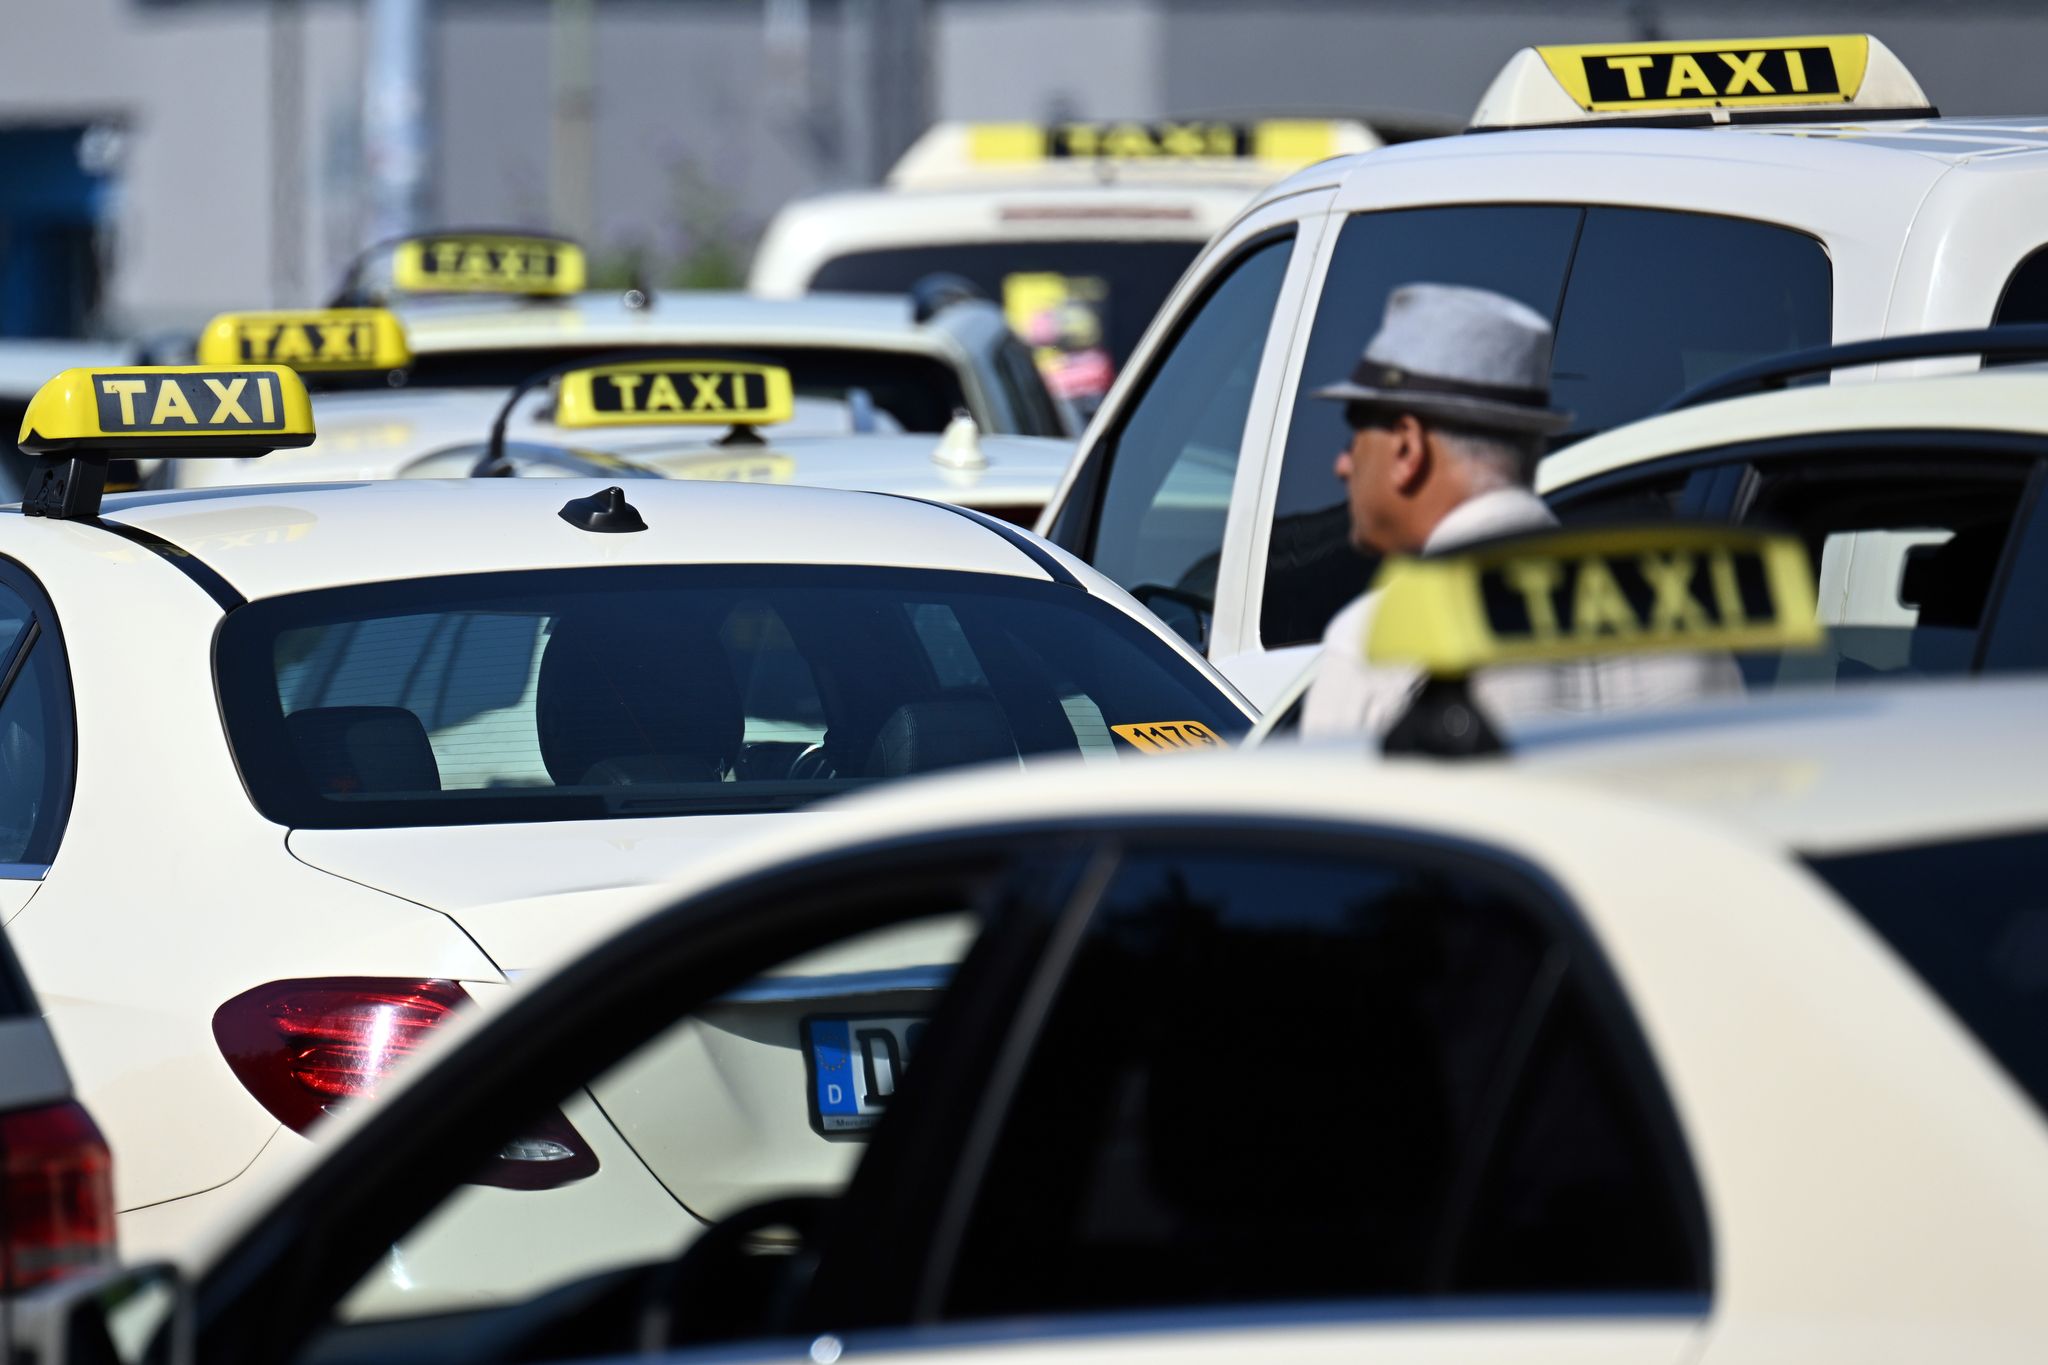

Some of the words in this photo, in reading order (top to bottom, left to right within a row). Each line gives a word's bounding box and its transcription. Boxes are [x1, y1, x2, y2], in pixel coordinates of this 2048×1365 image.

[1605, 50, 1809, 98] TAXI
[243, 324, 372, 363] TAXI
[102, 378, 276, 425] TAXI
[609, 373, 748, 412] TAXI
[1506, 549, 1745, 641] TAXI
[1132, 724, 1217, 749] 1179
[828, 1083, 842, 1104] D
